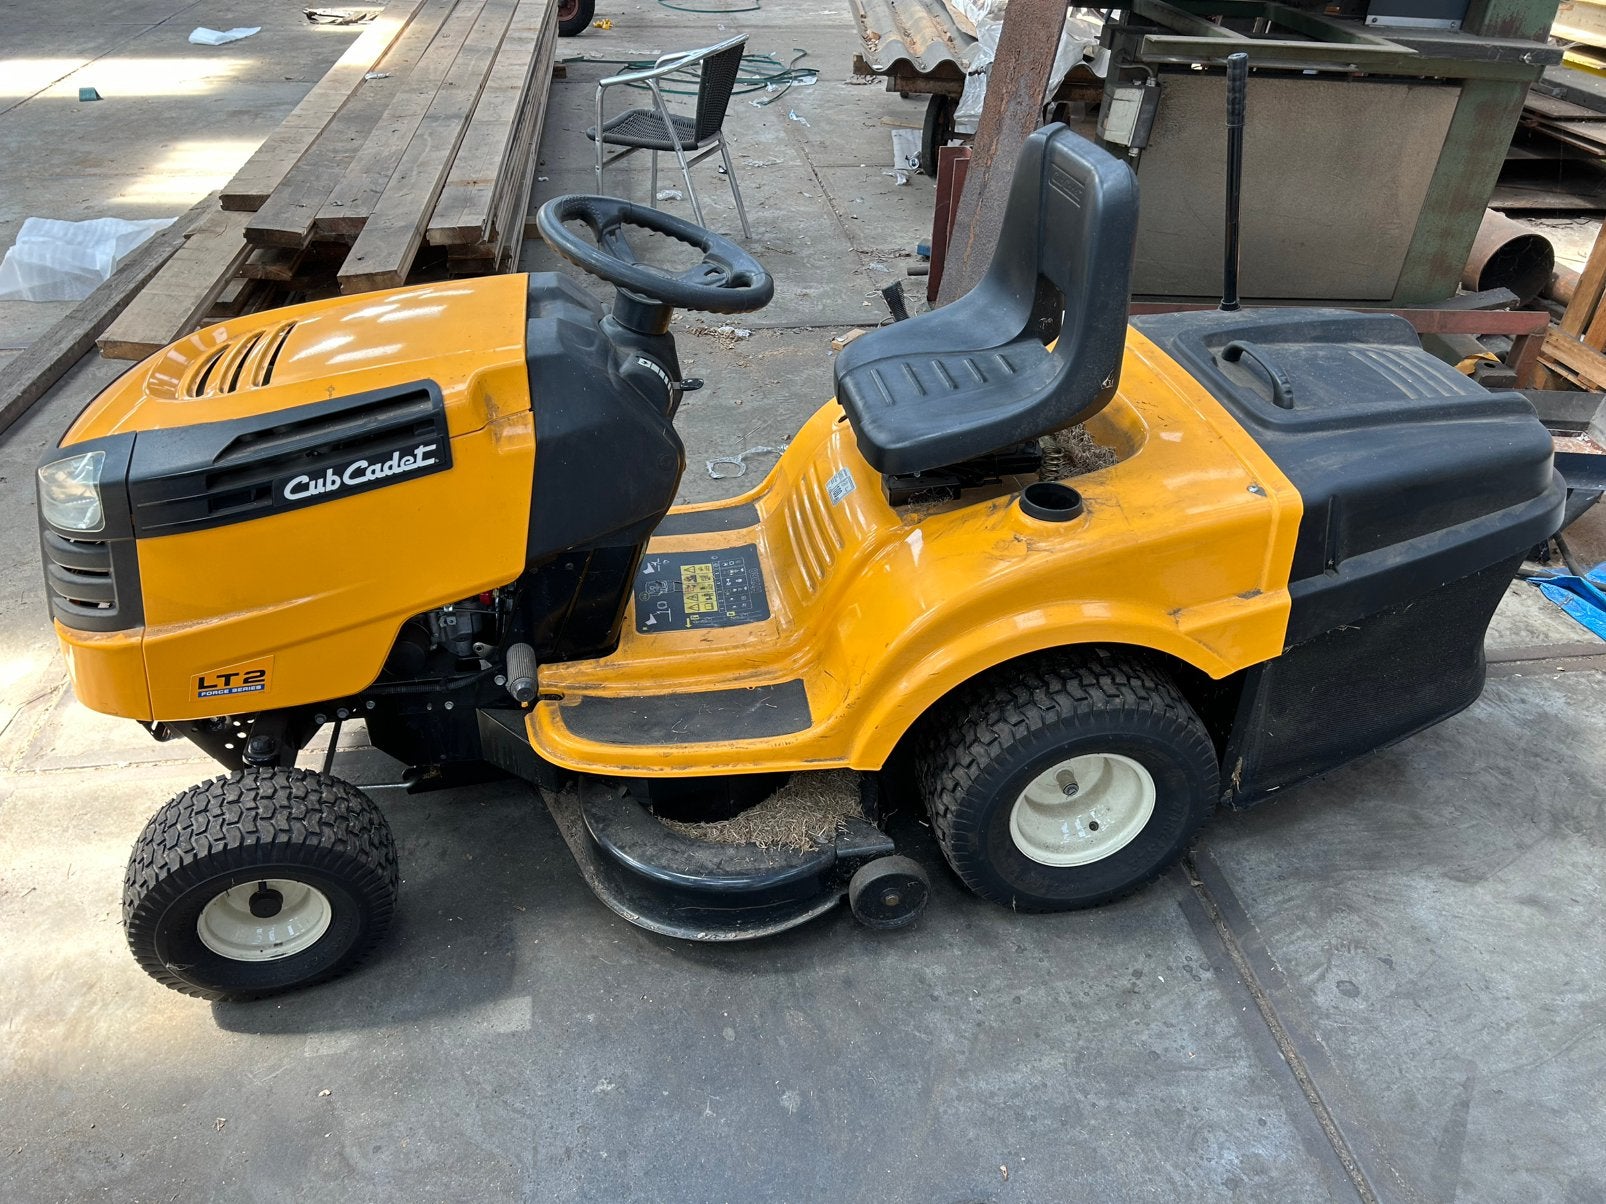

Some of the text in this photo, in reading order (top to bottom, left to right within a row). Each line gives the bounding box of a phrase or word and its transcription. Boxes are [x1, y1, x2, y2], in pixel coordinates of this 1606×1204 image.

[284, 444, 437, 500] Cub Cadet
[198, 670, 266, 690] LT2
[201, 685, 262, 697] FORCE SERIES
